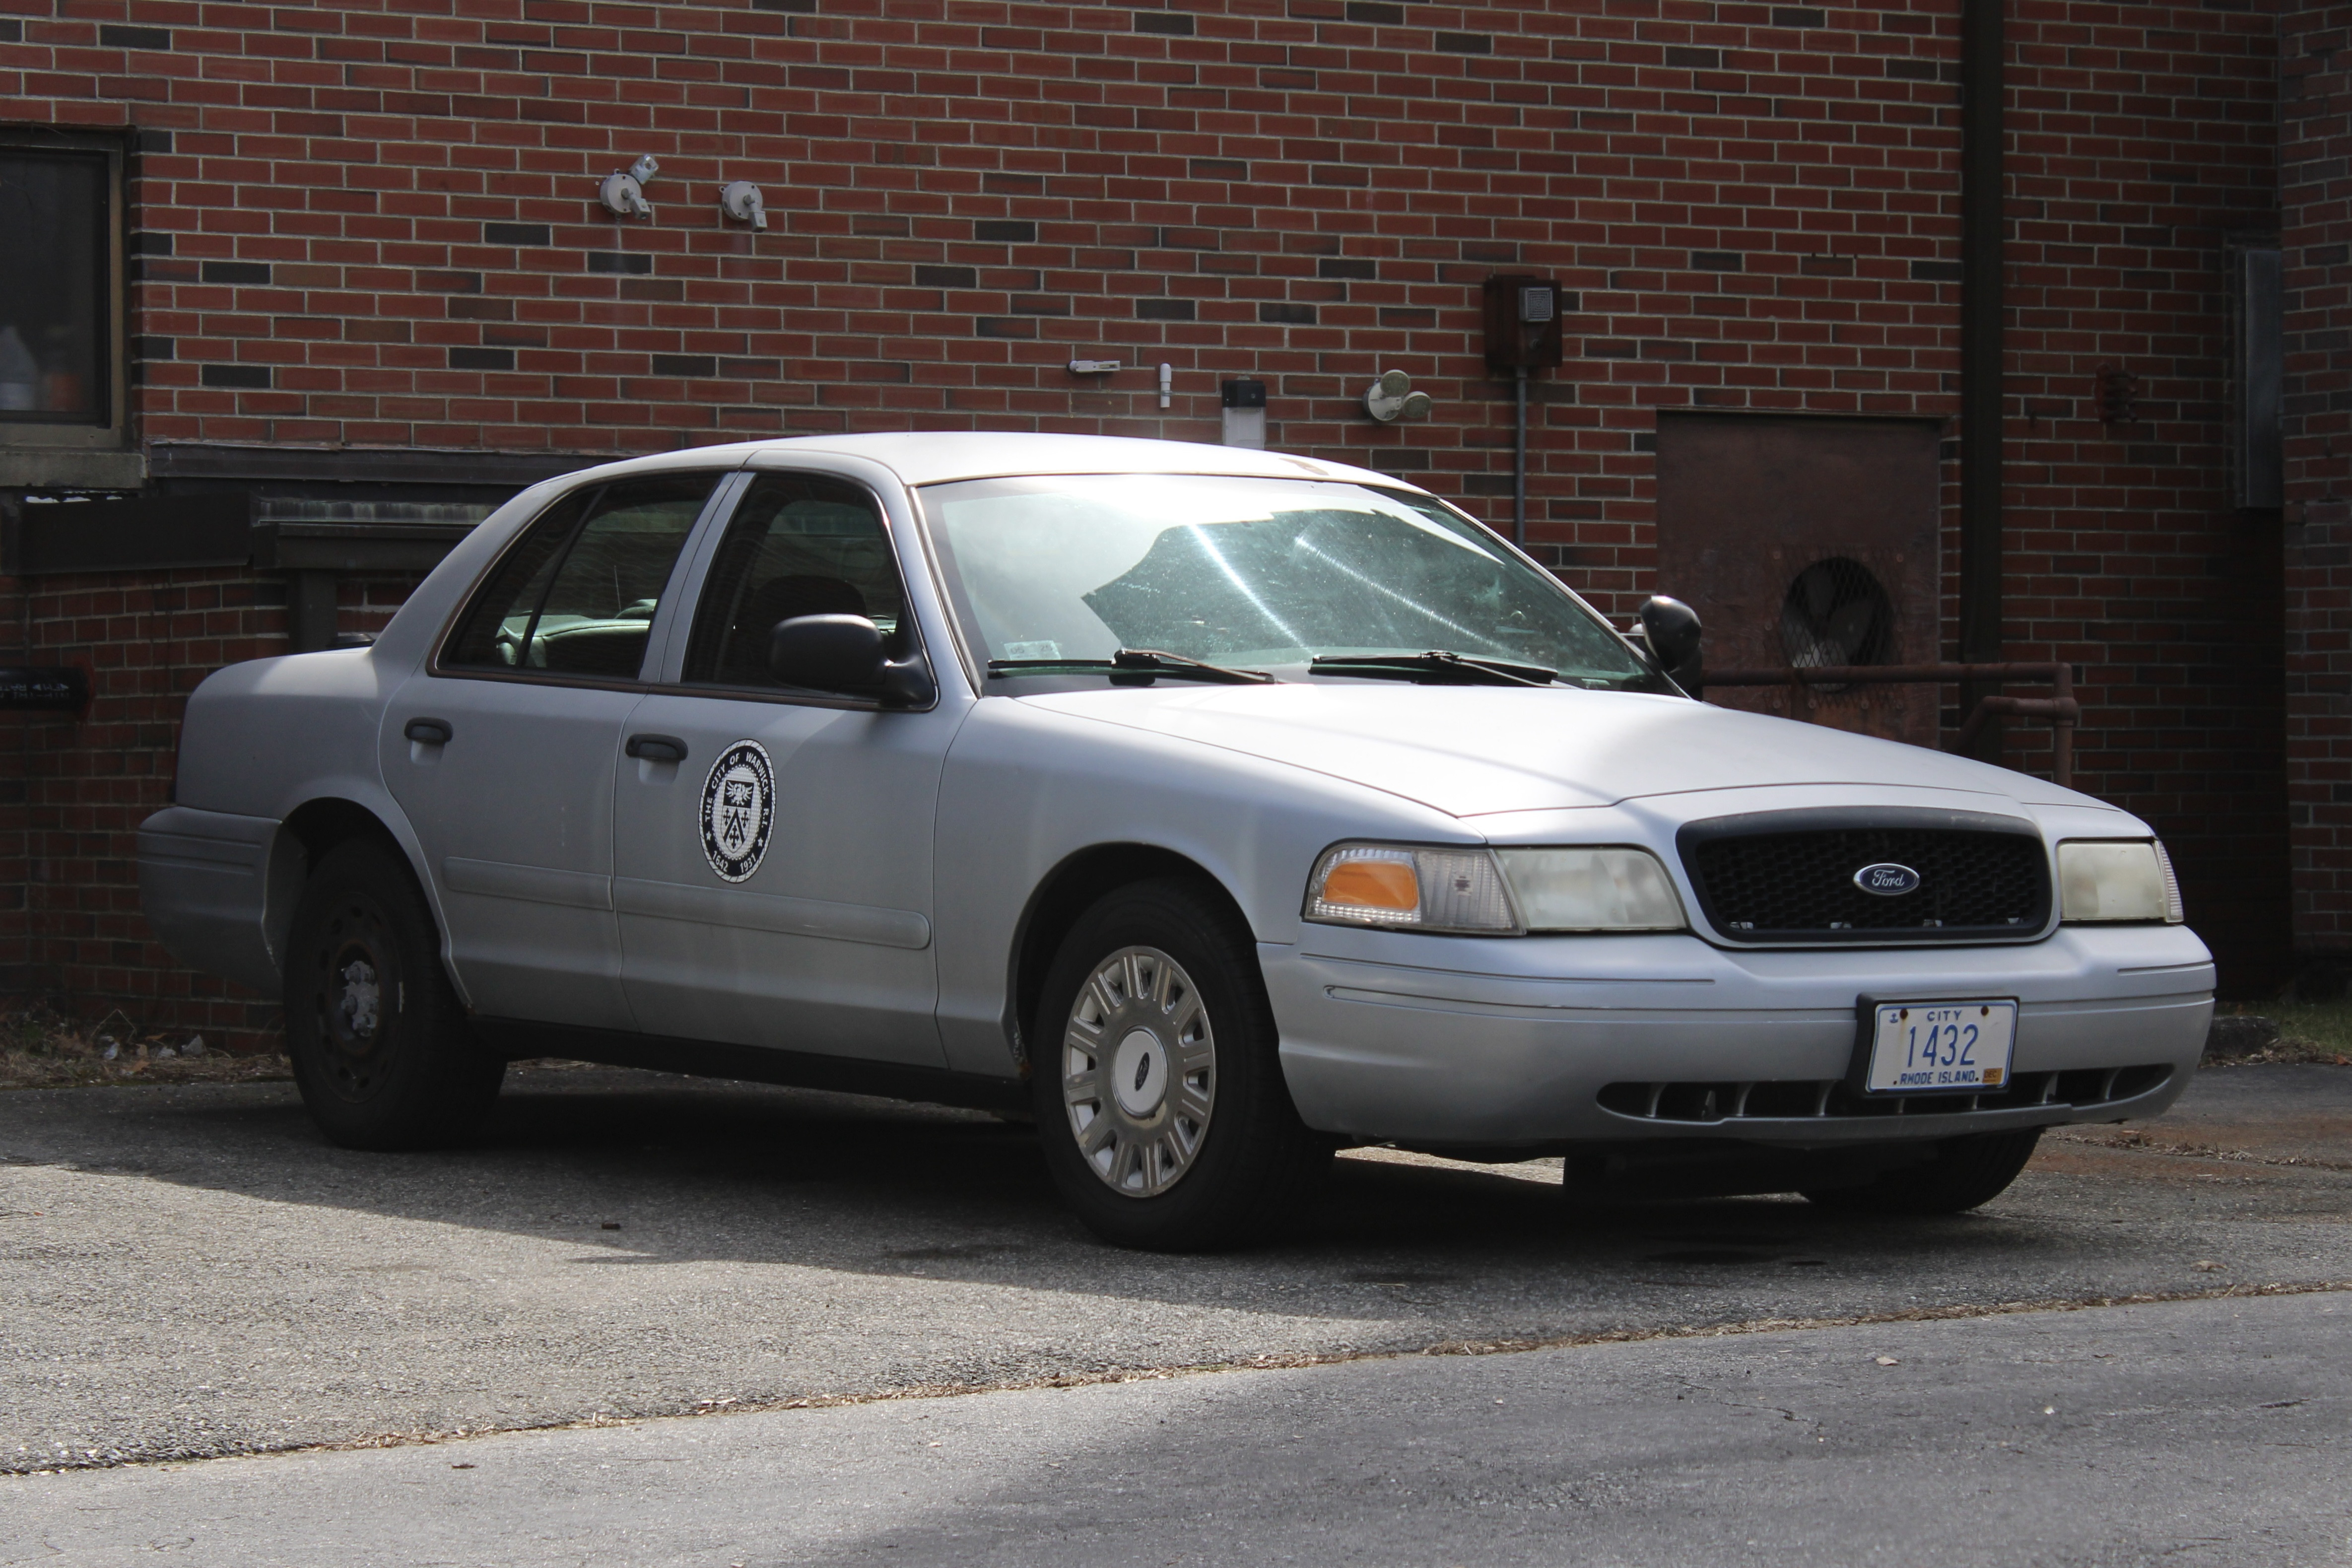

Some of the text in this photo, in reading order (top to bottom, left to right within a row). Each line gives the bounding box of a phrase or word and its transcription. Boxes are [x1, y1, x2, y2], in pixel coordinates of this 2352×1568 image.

[711, 763, 725, 789] CITY
[730, 752, 740, 765] OF
[713, 850, 756, 873] 1642 1931
[1872, 870, 1905, 886] Ford
[1927, 1010, 1962, 1022] CITY
[1908, 1024, 1978, 1067] 1432
[1900, 1070, 1975, 1085] RHODE ISLAND
